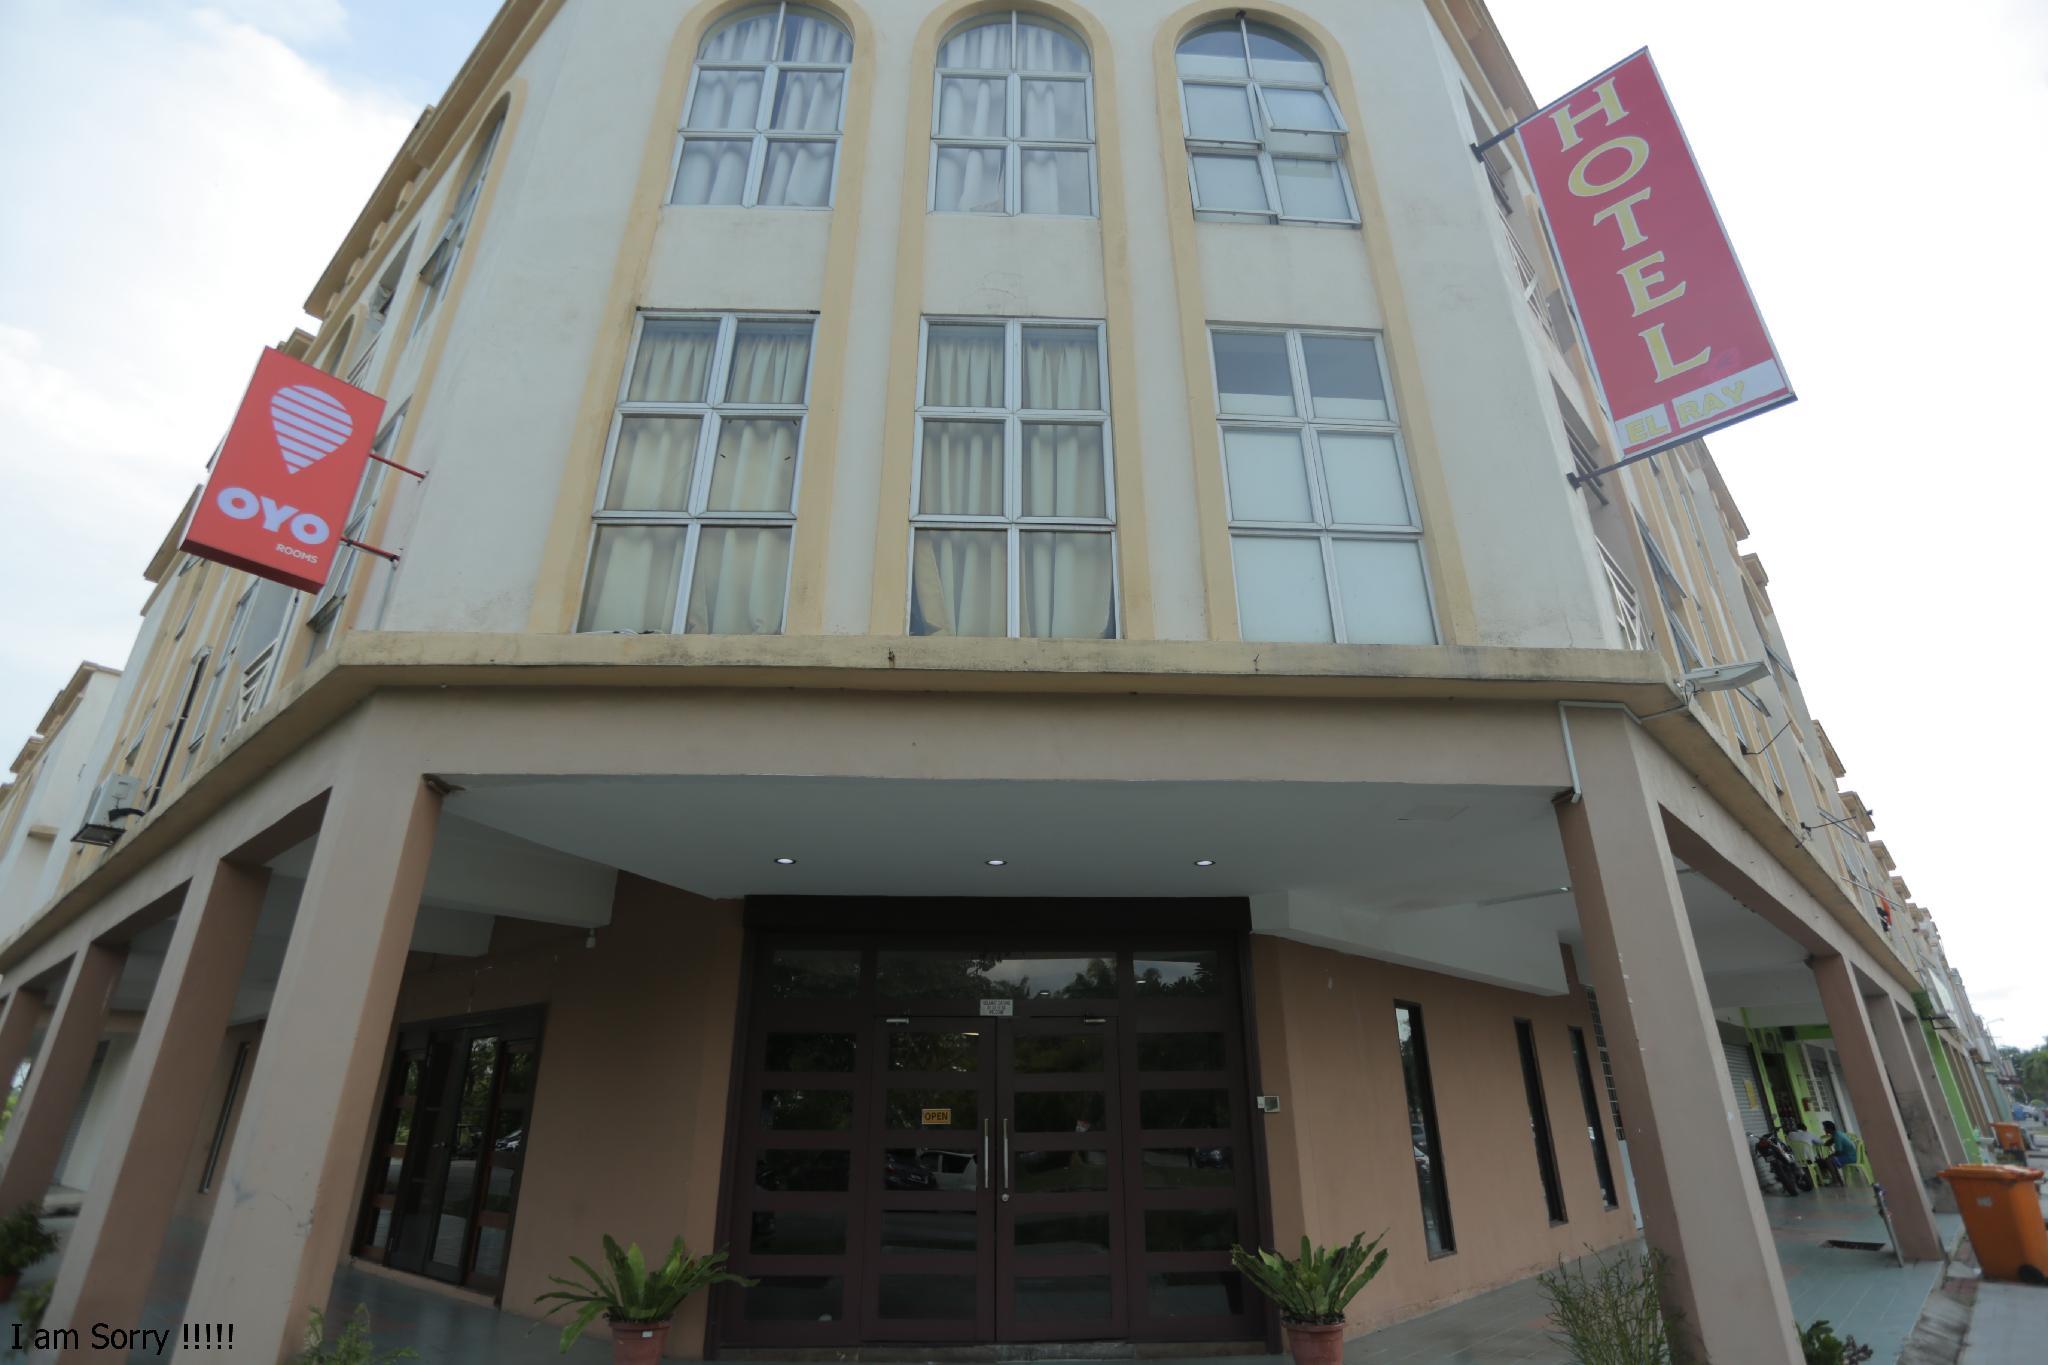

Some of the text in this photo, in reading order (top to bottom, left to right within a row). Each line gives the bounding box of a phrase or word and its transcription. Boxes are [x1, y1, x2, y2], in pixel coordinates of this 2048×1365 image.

[1549, 76, 1711, 383] HOTEL
[1625, 380, 1745, 443] EL RAY
[217, 487, 330, 545] OYO
[275, 543, 319, 564] ROOMS
[924, 1111, 948, 1121] OPEN
